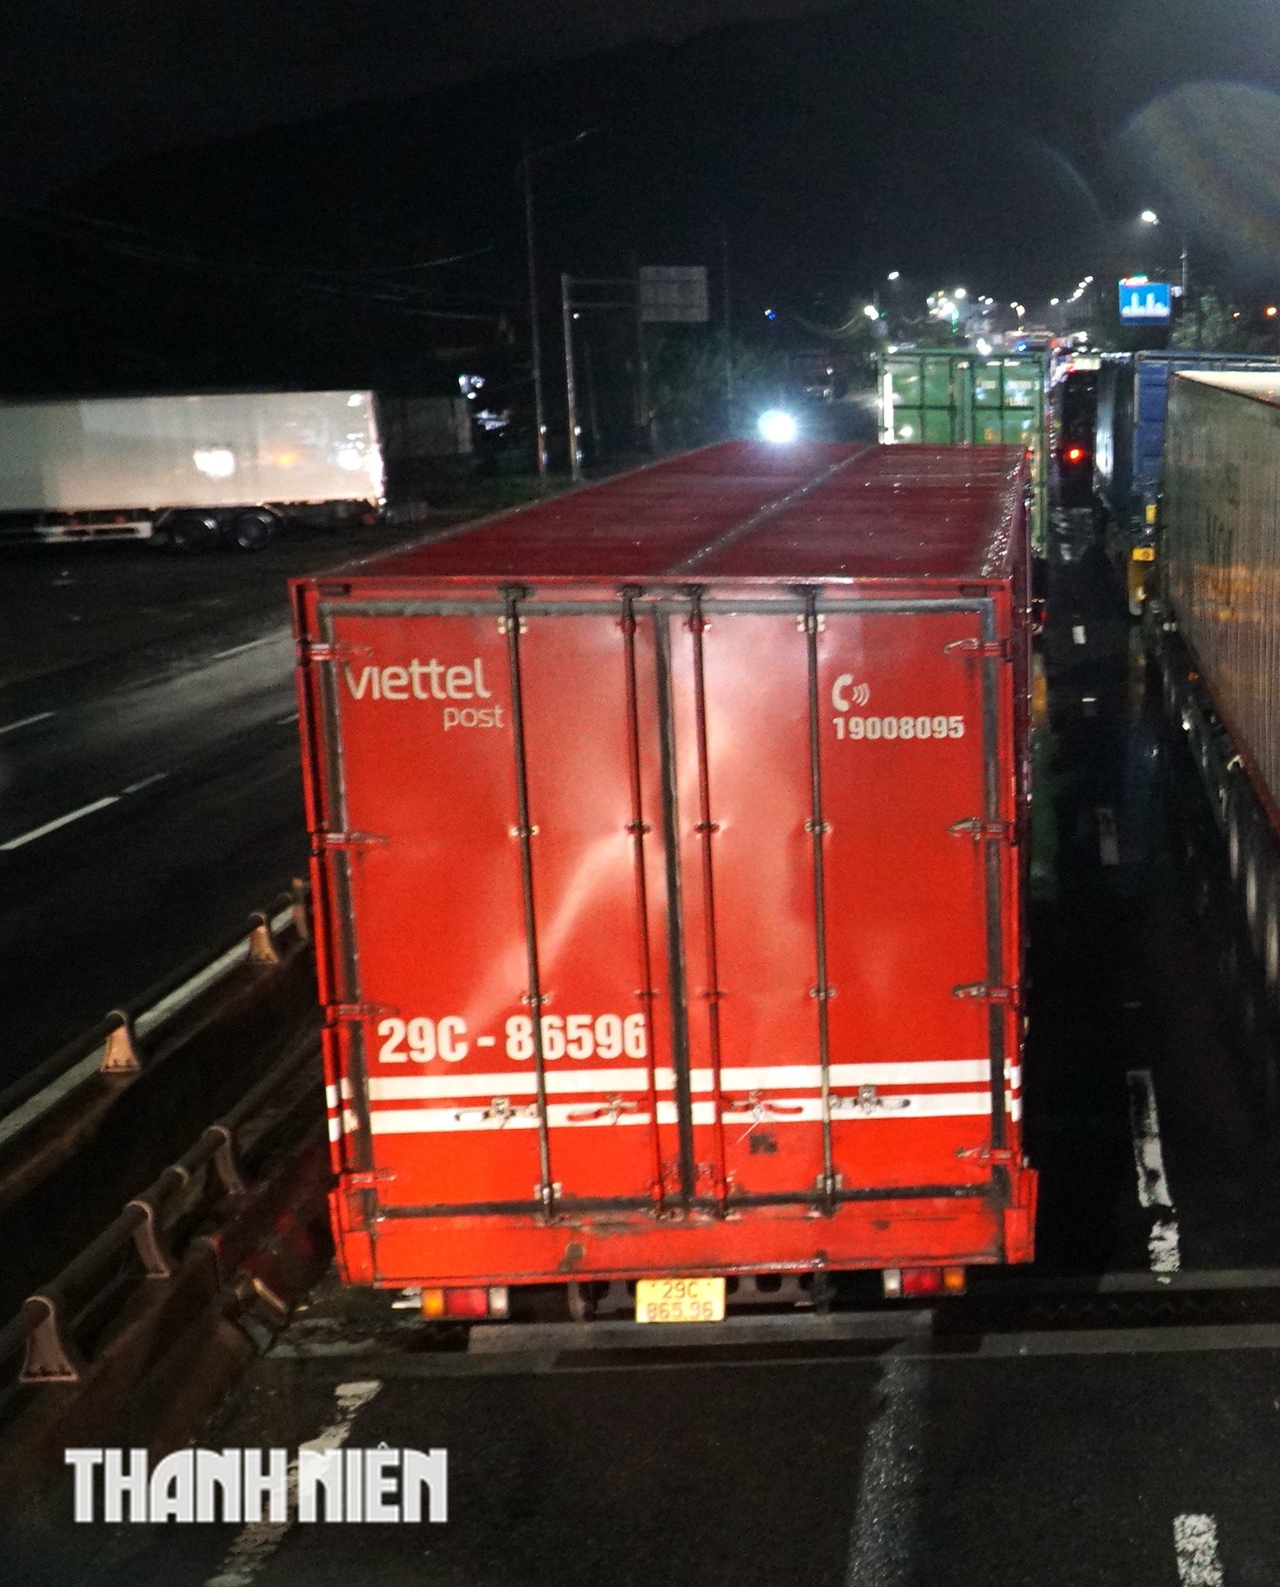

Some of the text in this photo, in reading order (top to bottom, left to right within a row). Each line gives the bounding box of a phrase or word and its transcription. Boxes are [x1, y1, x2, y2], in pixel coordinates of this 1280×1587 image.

[344, 657, 492, 700] viettel
[443, 703, 505, 731] post
[832, 715, 966, 740] 19008095
[662, 1281, 698, 1299] 29C
